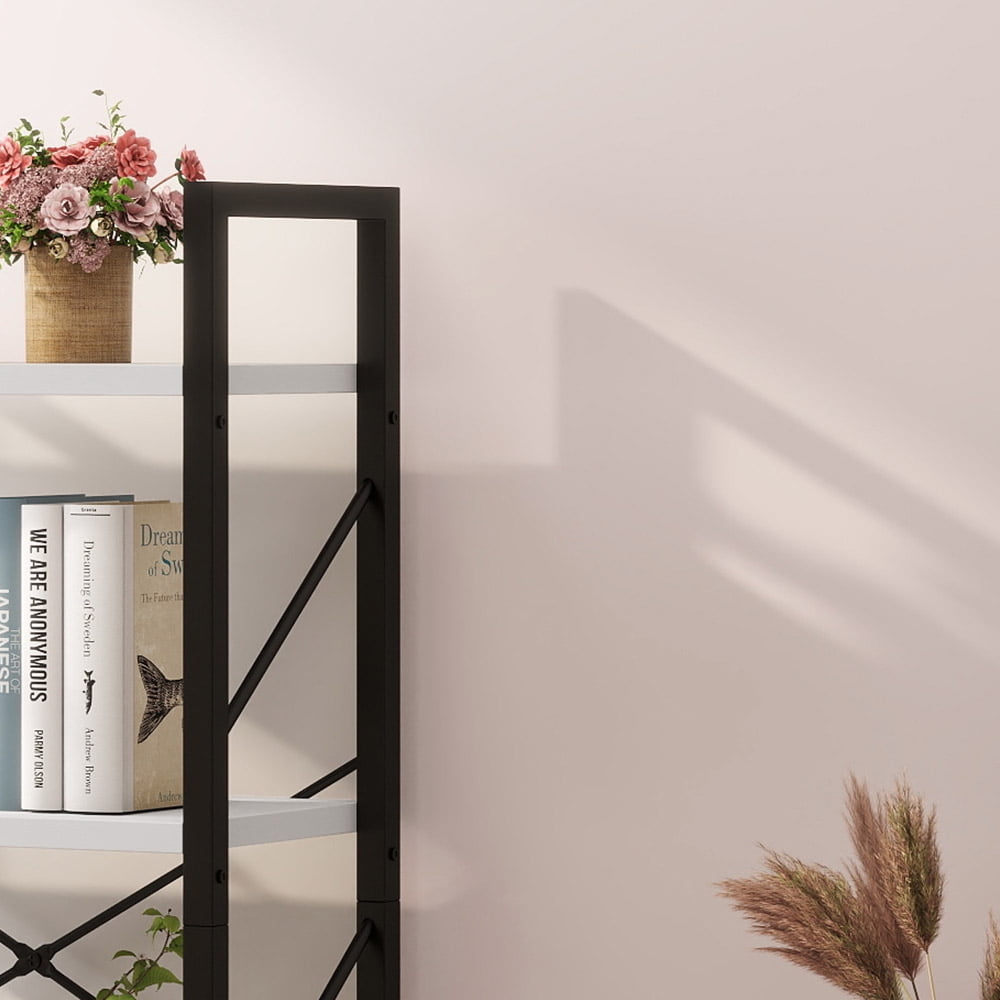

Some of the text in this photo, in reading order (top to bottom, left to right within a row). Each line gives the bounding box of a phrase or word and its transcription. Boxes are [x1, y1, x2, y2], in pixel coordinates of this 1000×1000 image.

[81, 540, 95, 657] Dreaming of Sweden
[147, 561, 159, 577] of
[29, 528, 48, 703] WE ARE ANONYMOUS
[10, 628, 20, 694] THE ART OF
[33, 729, 44, 789] PARMY OLSON
[84, 727, 94, 794] Andrew Brown
